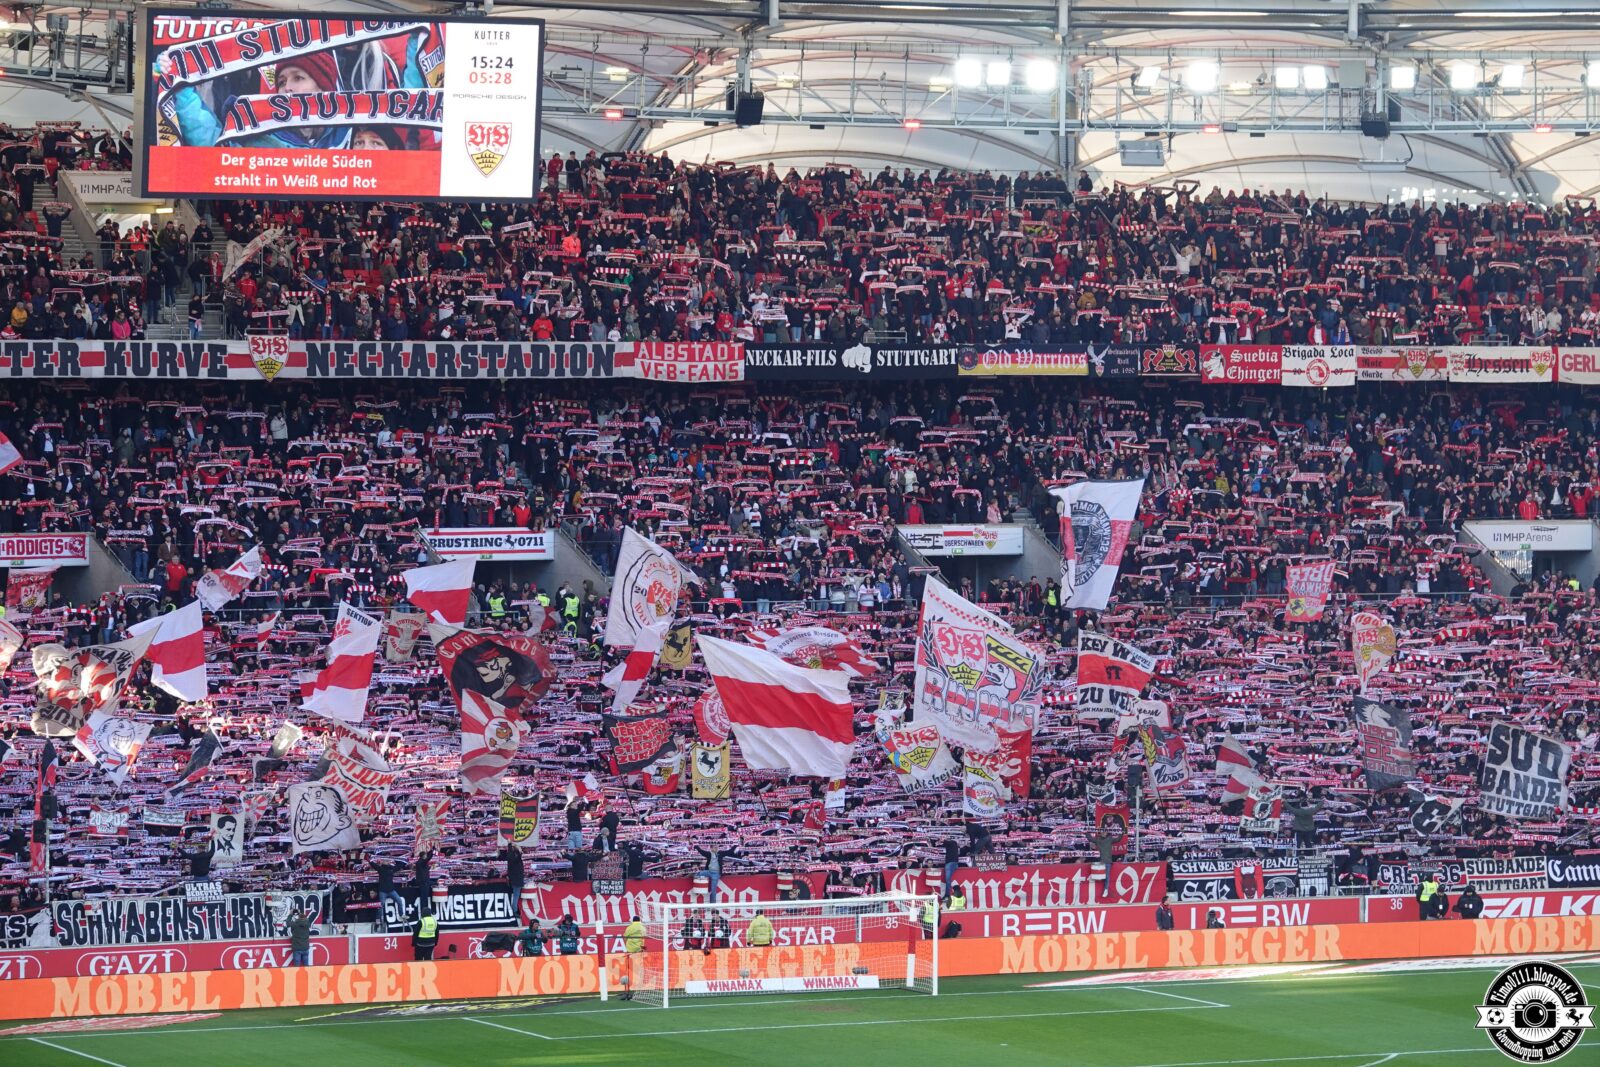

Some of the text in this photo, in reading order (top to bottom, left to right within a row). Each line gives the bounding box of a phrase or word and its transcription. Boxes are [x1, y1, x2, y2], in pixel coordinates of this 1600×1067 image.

[474, 30, 511, 41] KUTTER
[470, 55, 514, 69] 15:24
[468, 71, 513, 85] 05:28
[467, 124, 511, 148] VfB
[221, 153, 373, 169] Der ganze wilde Süden
[91, 184, 115, 194] MHP
[214, 173, 377, 188] strahlt in Weiß und Rot
[251, 336, 289, 355] VfB
[637, 342, 743, 361] ALBSTADT
[1282, 346, 1355, 360] Brigada Loca
[104, 342, 228, 377] KURVE
[305, 342, 615, 377] NECKARSTADION
[745, 348, 838, 367] NECKAR-FILS
[877, 348, 958, 367] STUTTGART
[982, 349, 1012, 369] Old
[1016, 348, 1087, 369] Warriors
[1464, 352, 1530, 377] Hessen
[639, 361, 740, 381] VFB-FANS
[1226, 366, 1282, 383] Ehingen
[1361, 370, 1383, 379] Garde
[429, 536, 503, 548] BRUSTRING
[944, 539, 984, 548] OBERSCHWABEN
[1503, 533, 1553, 542] MHP Arena
[6, 538, 64, 555] ADDICTS
[1482, 767, 1562, 805] BANDE
[1478, 793, 1555, 819] STUTTGART
[1465, 856, 1546, 875] SÜDBANDE
[185, 881, 222, 892] ULTRAS
[1115, 865, 1161, 904] 97
[1468, 876, 1547, 892] STUTTGART
[1390, 899, 1403, 911] 36
[885, 916, 898, 930] 35
[384, 936, 398, 951] 34
[999, 924, 1344, 973] MÖBEL RIEGER
[675, 943, 863, 991] RIEGER
[51, 960, 441, 1018] MÖBEL RIEGER
[706, 975, 859, 992] WINAMAX WINAMAX
